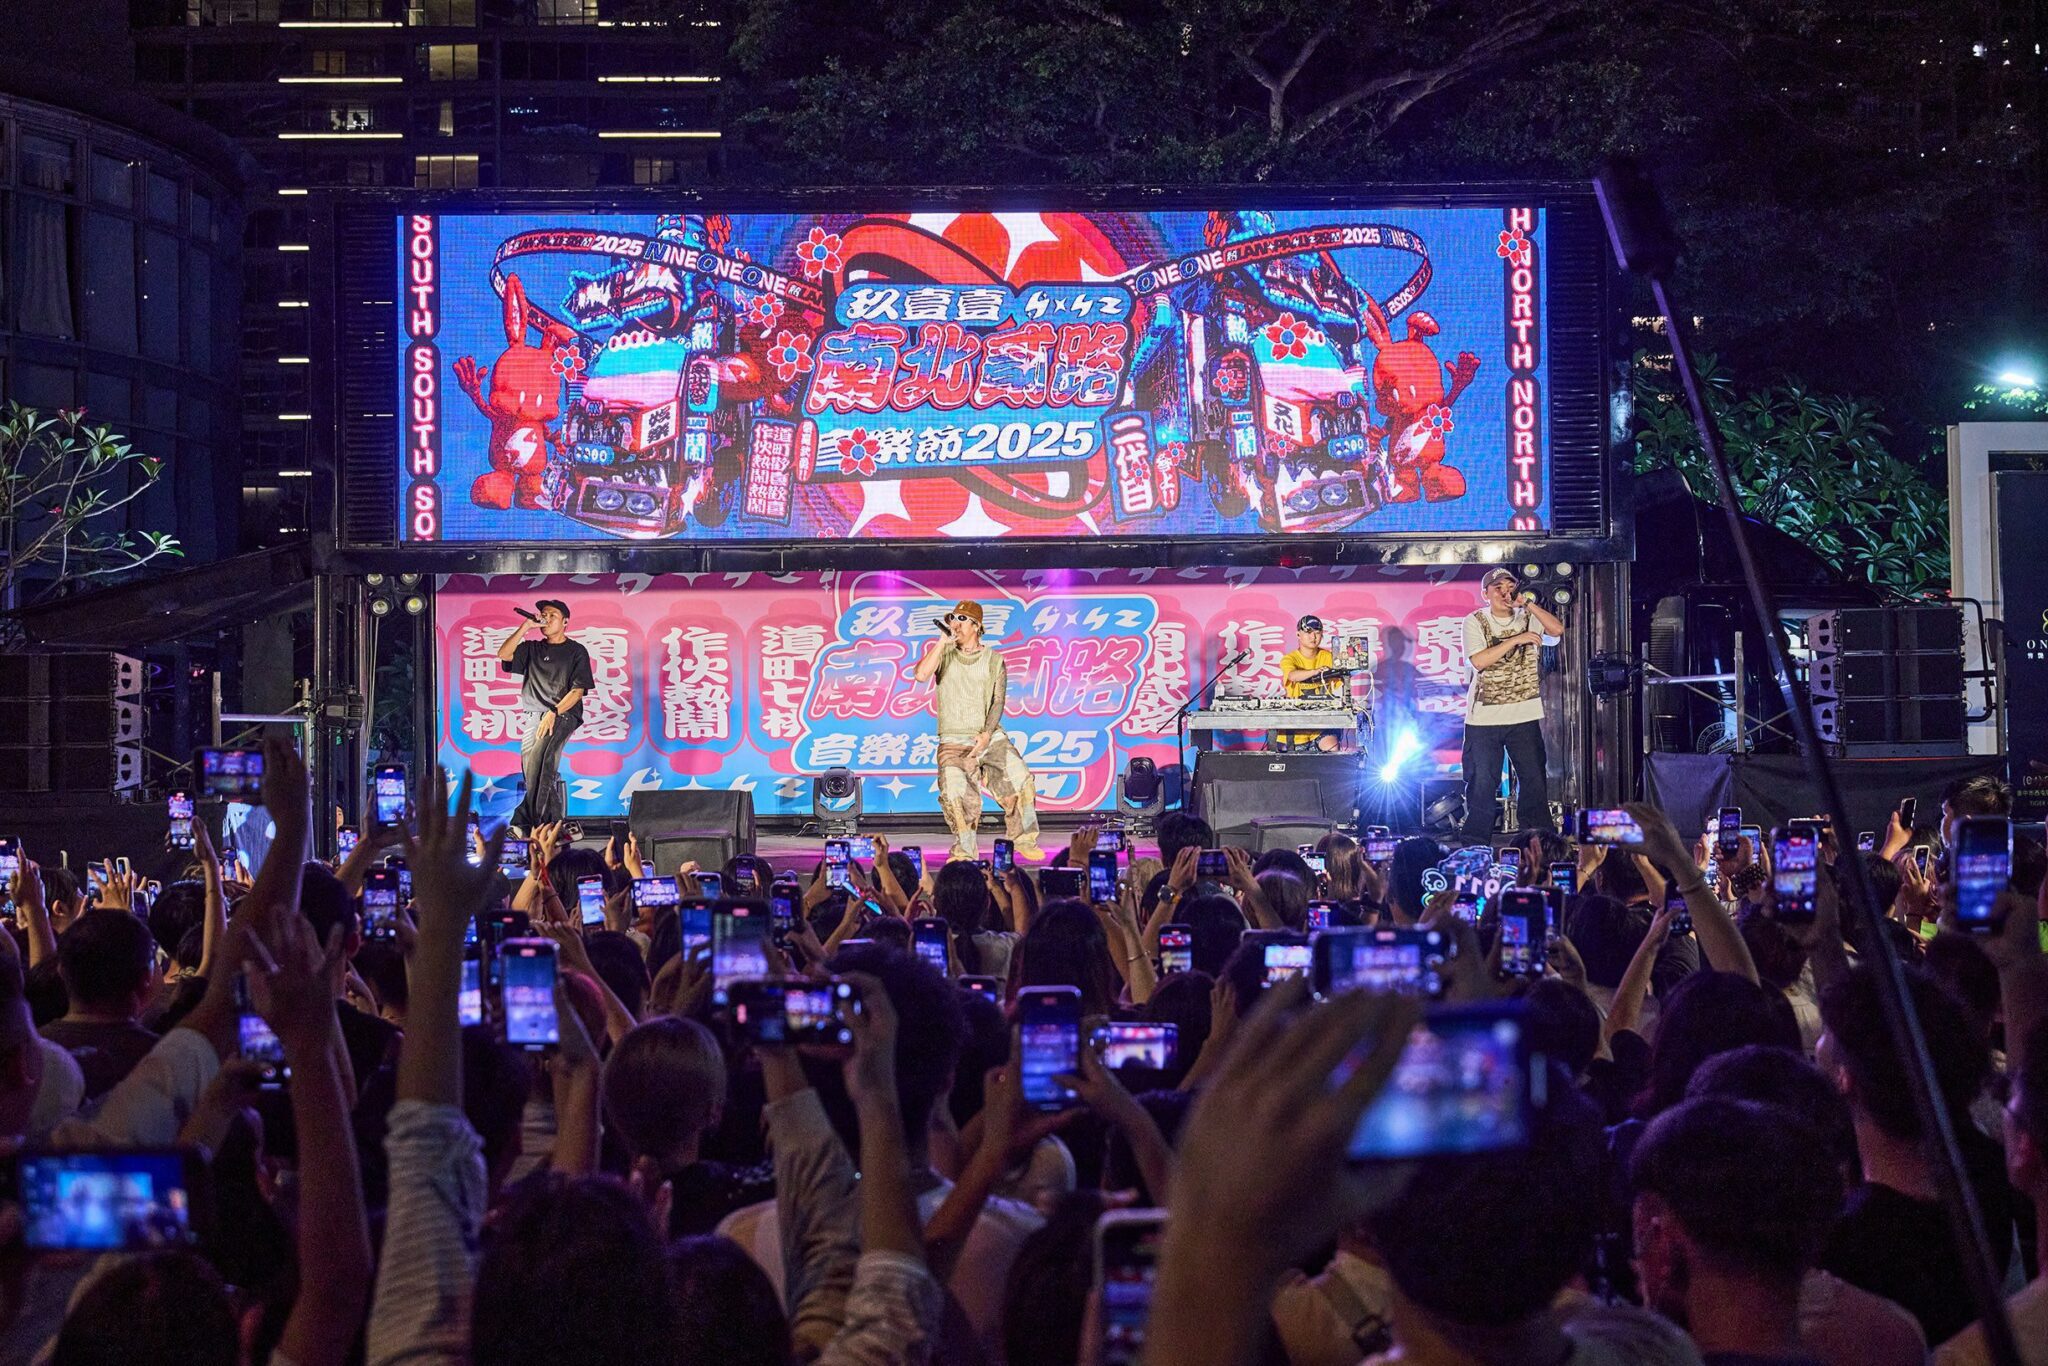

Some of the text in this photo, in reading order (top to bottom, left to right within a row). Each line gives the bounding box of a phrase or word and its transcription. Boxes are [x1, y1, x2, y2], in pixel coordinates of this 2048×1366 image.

[591, 235, 645, 256] 2025
[1342, 228, 1381, 244] 2025
[848, 288, 1006, 321] 玖壹壹
[413, 347, 436, 475] SOUTH
[1511, 379, 1535, 507] NORTH
